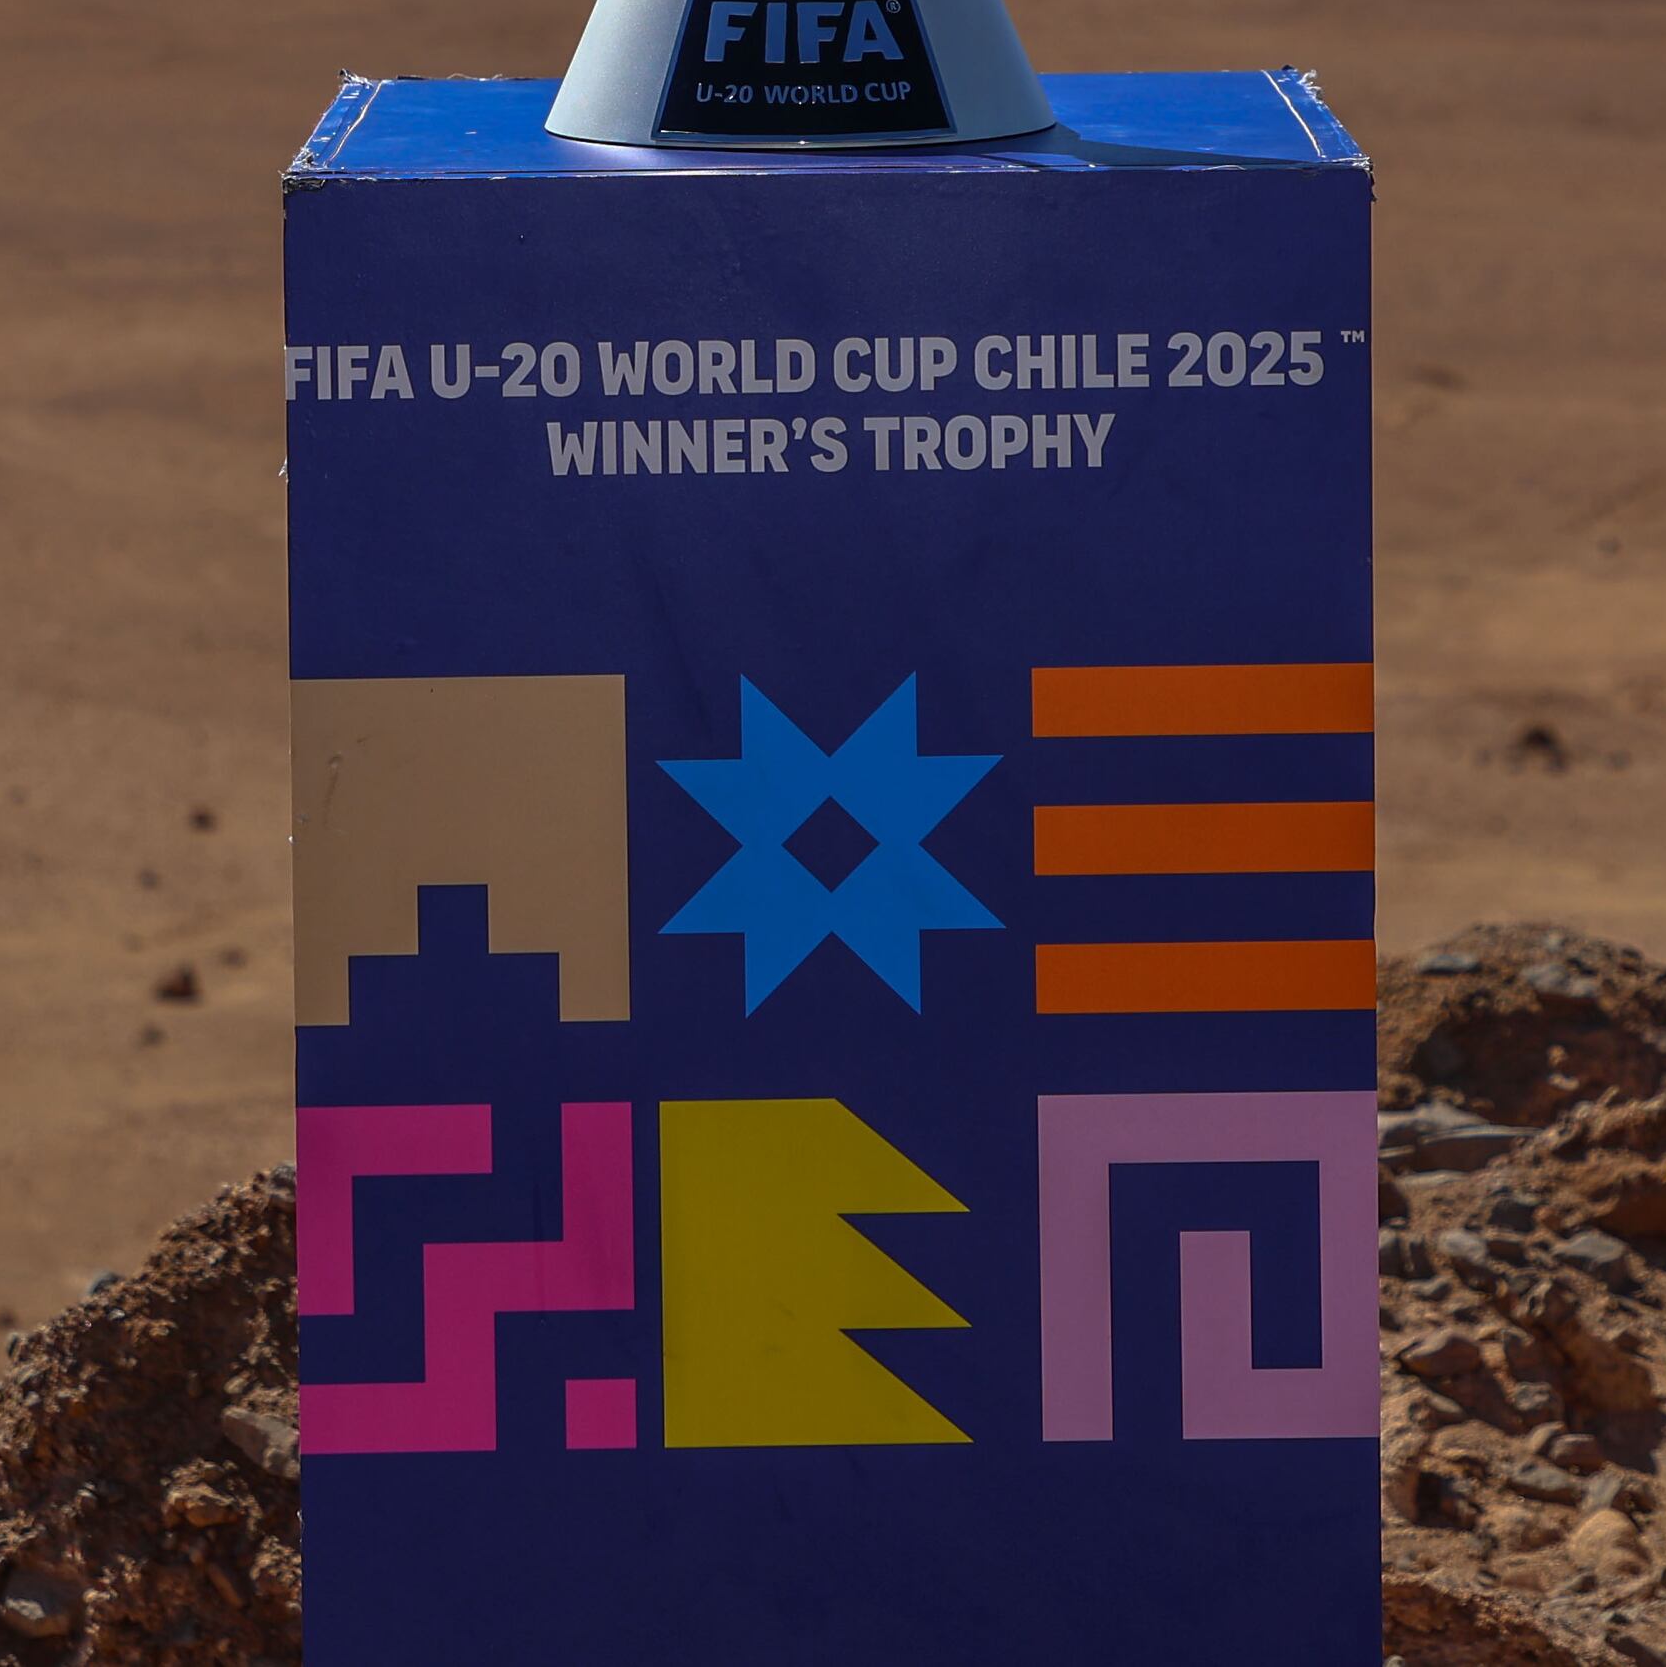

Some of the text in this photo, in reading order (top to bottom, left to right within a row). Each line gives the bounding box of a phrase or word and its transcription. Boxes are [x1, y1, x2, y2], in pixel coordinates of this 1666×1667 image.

[696, 81, 912, 105] U-20 WORLD CUP
[285, 344, 414, 401] FIFA
[430, 342, 581, 398] U-20
[598, 339, 816, 396] WORLD
[833, 337, 959, 393] CUP
[974, 335, 1151, 389] CHILE
[863, 413, 1115, 471] TROPHY
